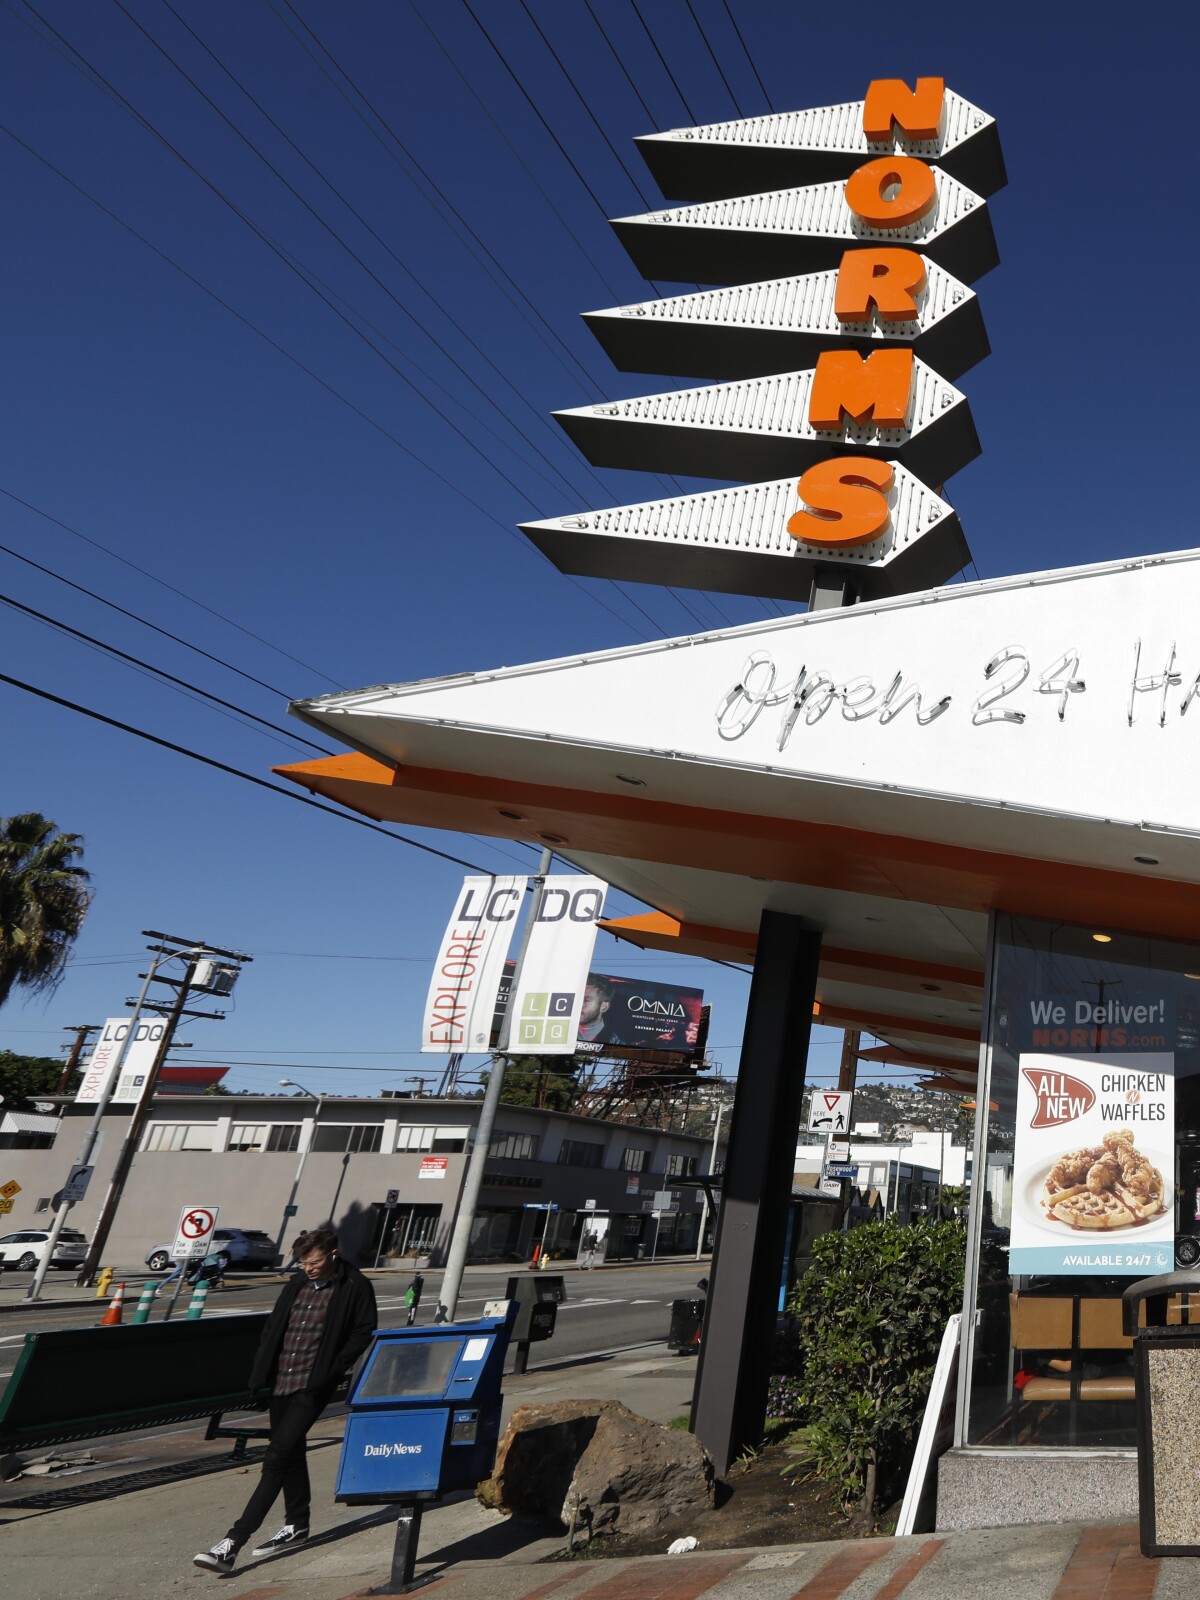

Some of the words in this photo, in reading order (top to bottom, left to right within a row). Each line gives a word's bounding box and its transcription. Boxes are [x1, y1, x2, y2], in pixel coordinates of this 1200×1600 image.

[787, 76, 946, 549] NORMS
[716, 649, 952, 752] Open
[971, 644, 1087, 726] 24
[429, 928, 487, 1045] EXPLORE
[627, 995, 686, 1018] OMNIA
[1030, 1000, 1066, 1025] We
[1074, 999, 1165, 1025] Deliver!
[1031, 1028, 1165, 1048] NORMS.com
[80, 1044, 114, 1100] EXPLORE
[1038, 1075, 1069, 1097] ALL
[1101, 1074, 1166, 1093] CHICKEN
[1046, 1097, 1087, 1120] NEW
[1101, 1103, 1165, 1121] WAFFLES
[826, 1165, 852, 1173] Rosewood
[483, 1174, 543, 1188] UFENKIAN
[1062, 1256, 1123, 1267] AVAILABLE
[1125, 1255, 1151, 1267] 24/7
[364, 1443, 393, 1458] Daily
[393, 1443, 422, 1455] News
